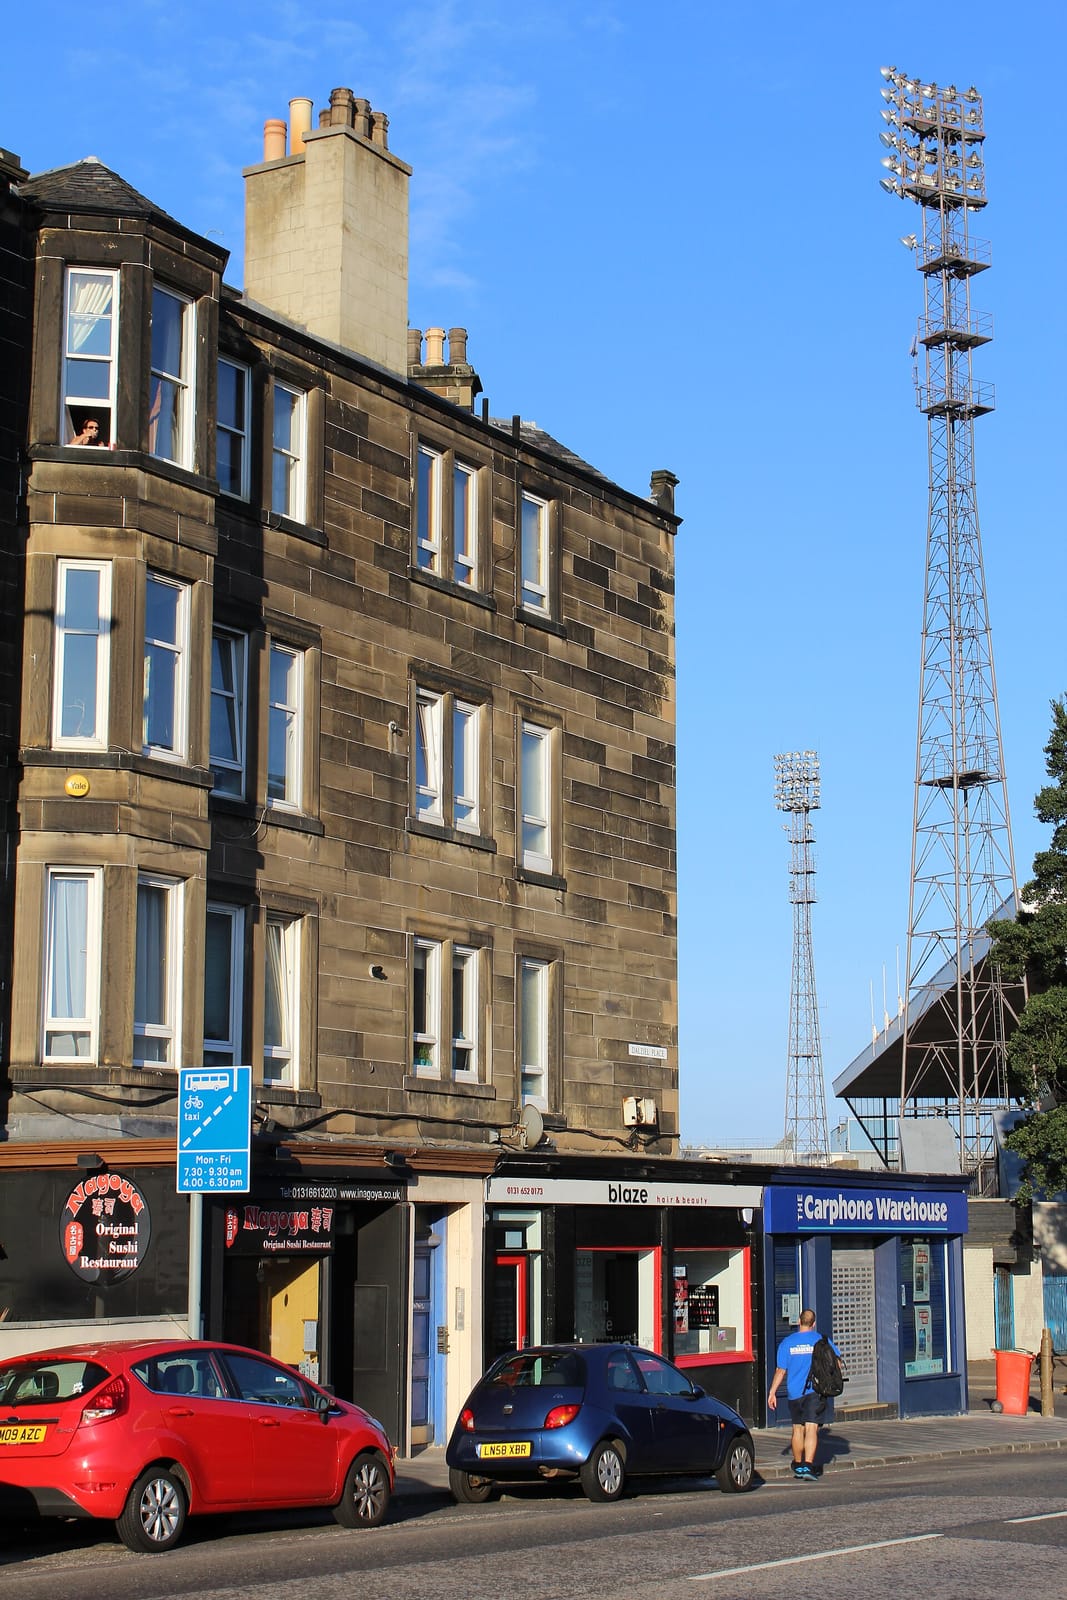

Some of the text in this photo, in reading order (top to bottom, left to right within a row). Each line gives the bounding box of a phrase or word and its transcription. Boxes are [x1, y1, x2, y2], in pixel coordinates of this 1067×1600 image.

[70, 782, 86, 790] Yale
[184, 1112, 200, 1121] taxi
[195, 1155, 214, 1164] Mon
[220, 1154, 231, 1164] Fri
[184, 1167, 203, 1177] 7.30
[208, 1167, 228, 1176] 9.30
[229, 1168, 242, 1176] am
[183, 1178, 203, 1187] 4.00
[209, 1178, 229, 1187] 6.30
[230, 1179, 243, 1188] pm
[65, 1174, 144, 1217] Nagoya
[340, 1188, 401, 1200] www.inagoya.co.uk
[507, 1186, 543, 1195] 0131 652 0173
[608, 1184, 648, 1203] blaze
[656, 1195, 708, 1206] hair & beauty
[804, 1194, 873, 1225] Carphone
[876, 1196, 948, 1222] Warehouse
[243, 1205, 309, 1236] Nagoya
[96, 1222, 138, 1239] Original
[109, 1240, 138, 1254] Sushi
[263, 1239, 332, 1251] Original Sushi Restaurant
[80, 1256, 138, 1268] Restaurant
[20, 1428, 41, 1441] AZC
[484, 1444, 527, 1456] LN58 XBR
